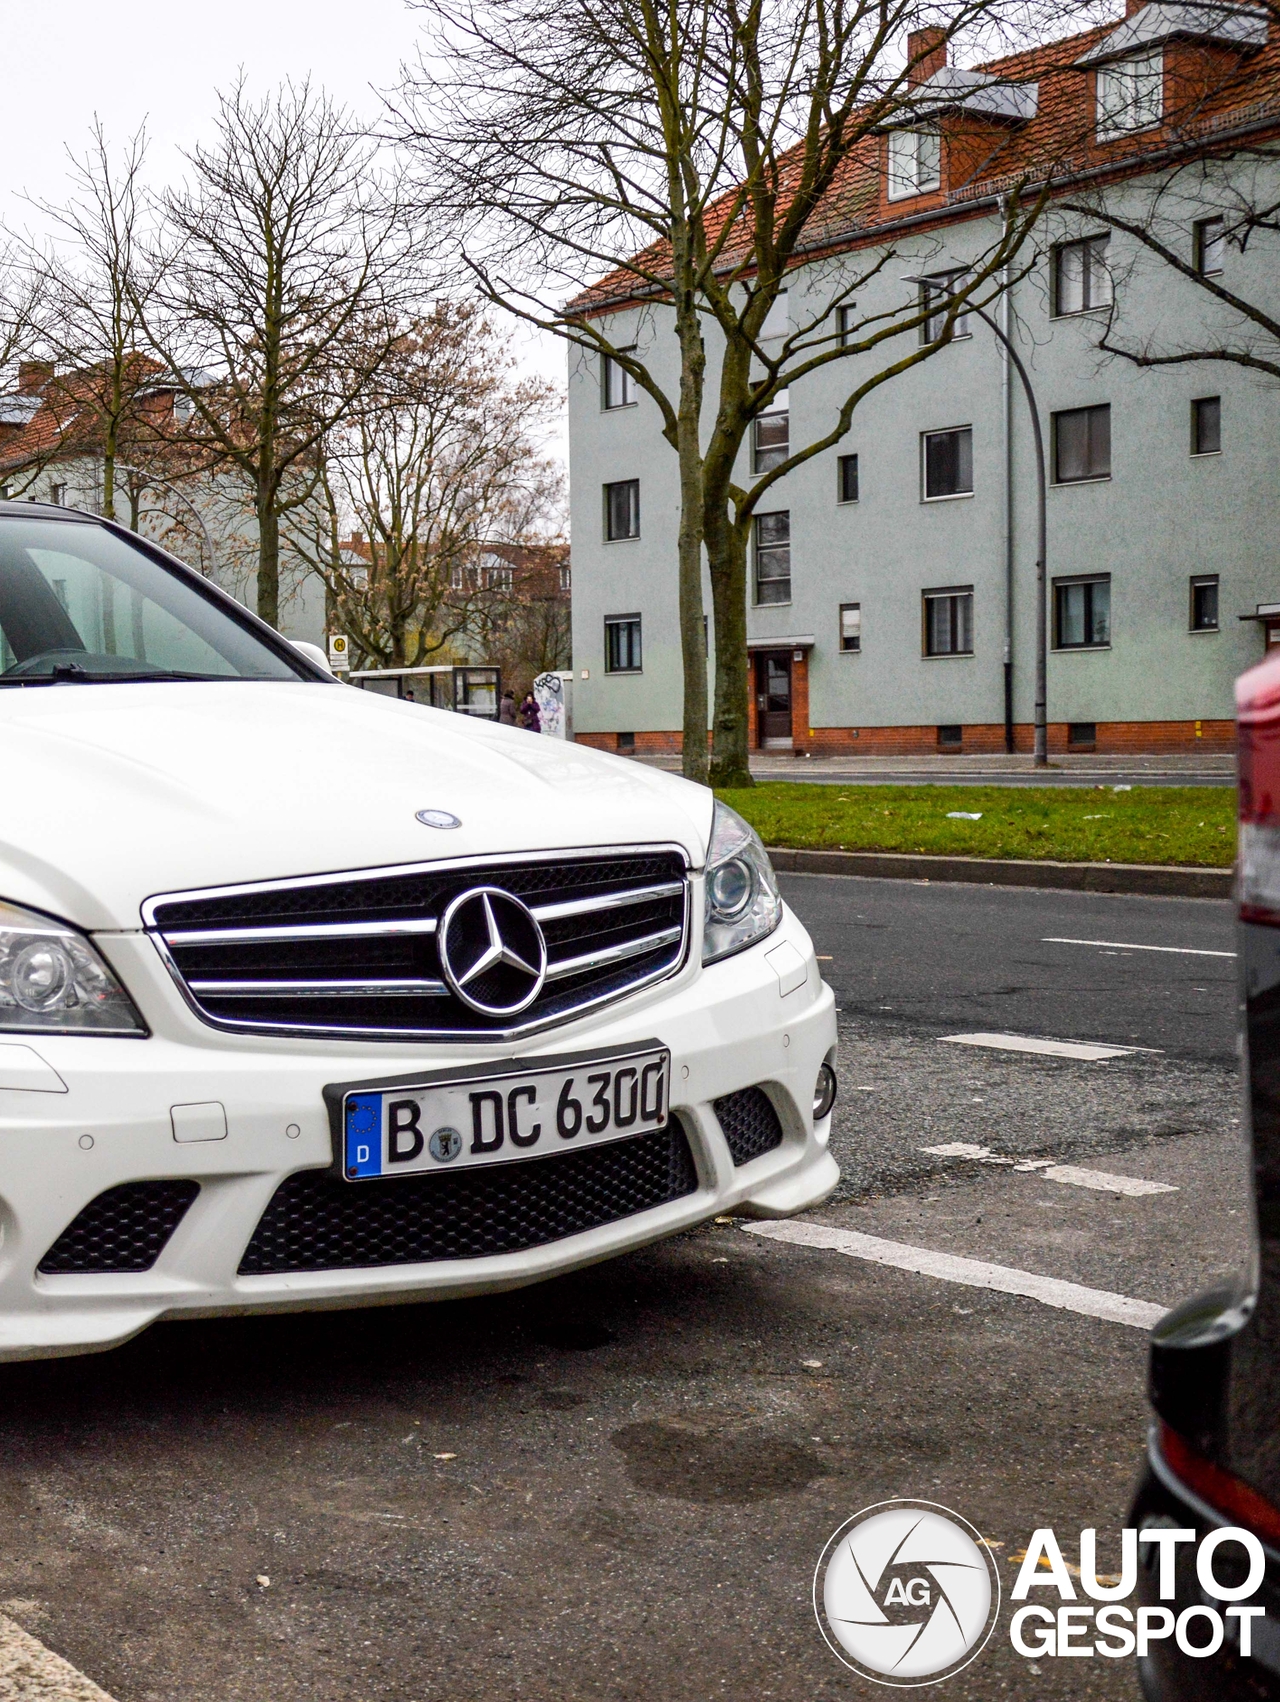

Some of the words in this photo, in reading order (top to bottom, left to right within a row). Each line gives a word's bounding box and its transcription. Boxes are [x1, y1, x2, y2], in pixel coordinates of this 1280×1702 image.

[337, 641, 343, 649] H
[388, 1099, 424, 1163] B
[469, 1085, 541, 1154] DC
[556, 1062, 665, 1139] 6300
[357, 1145, 369, 1163] D
